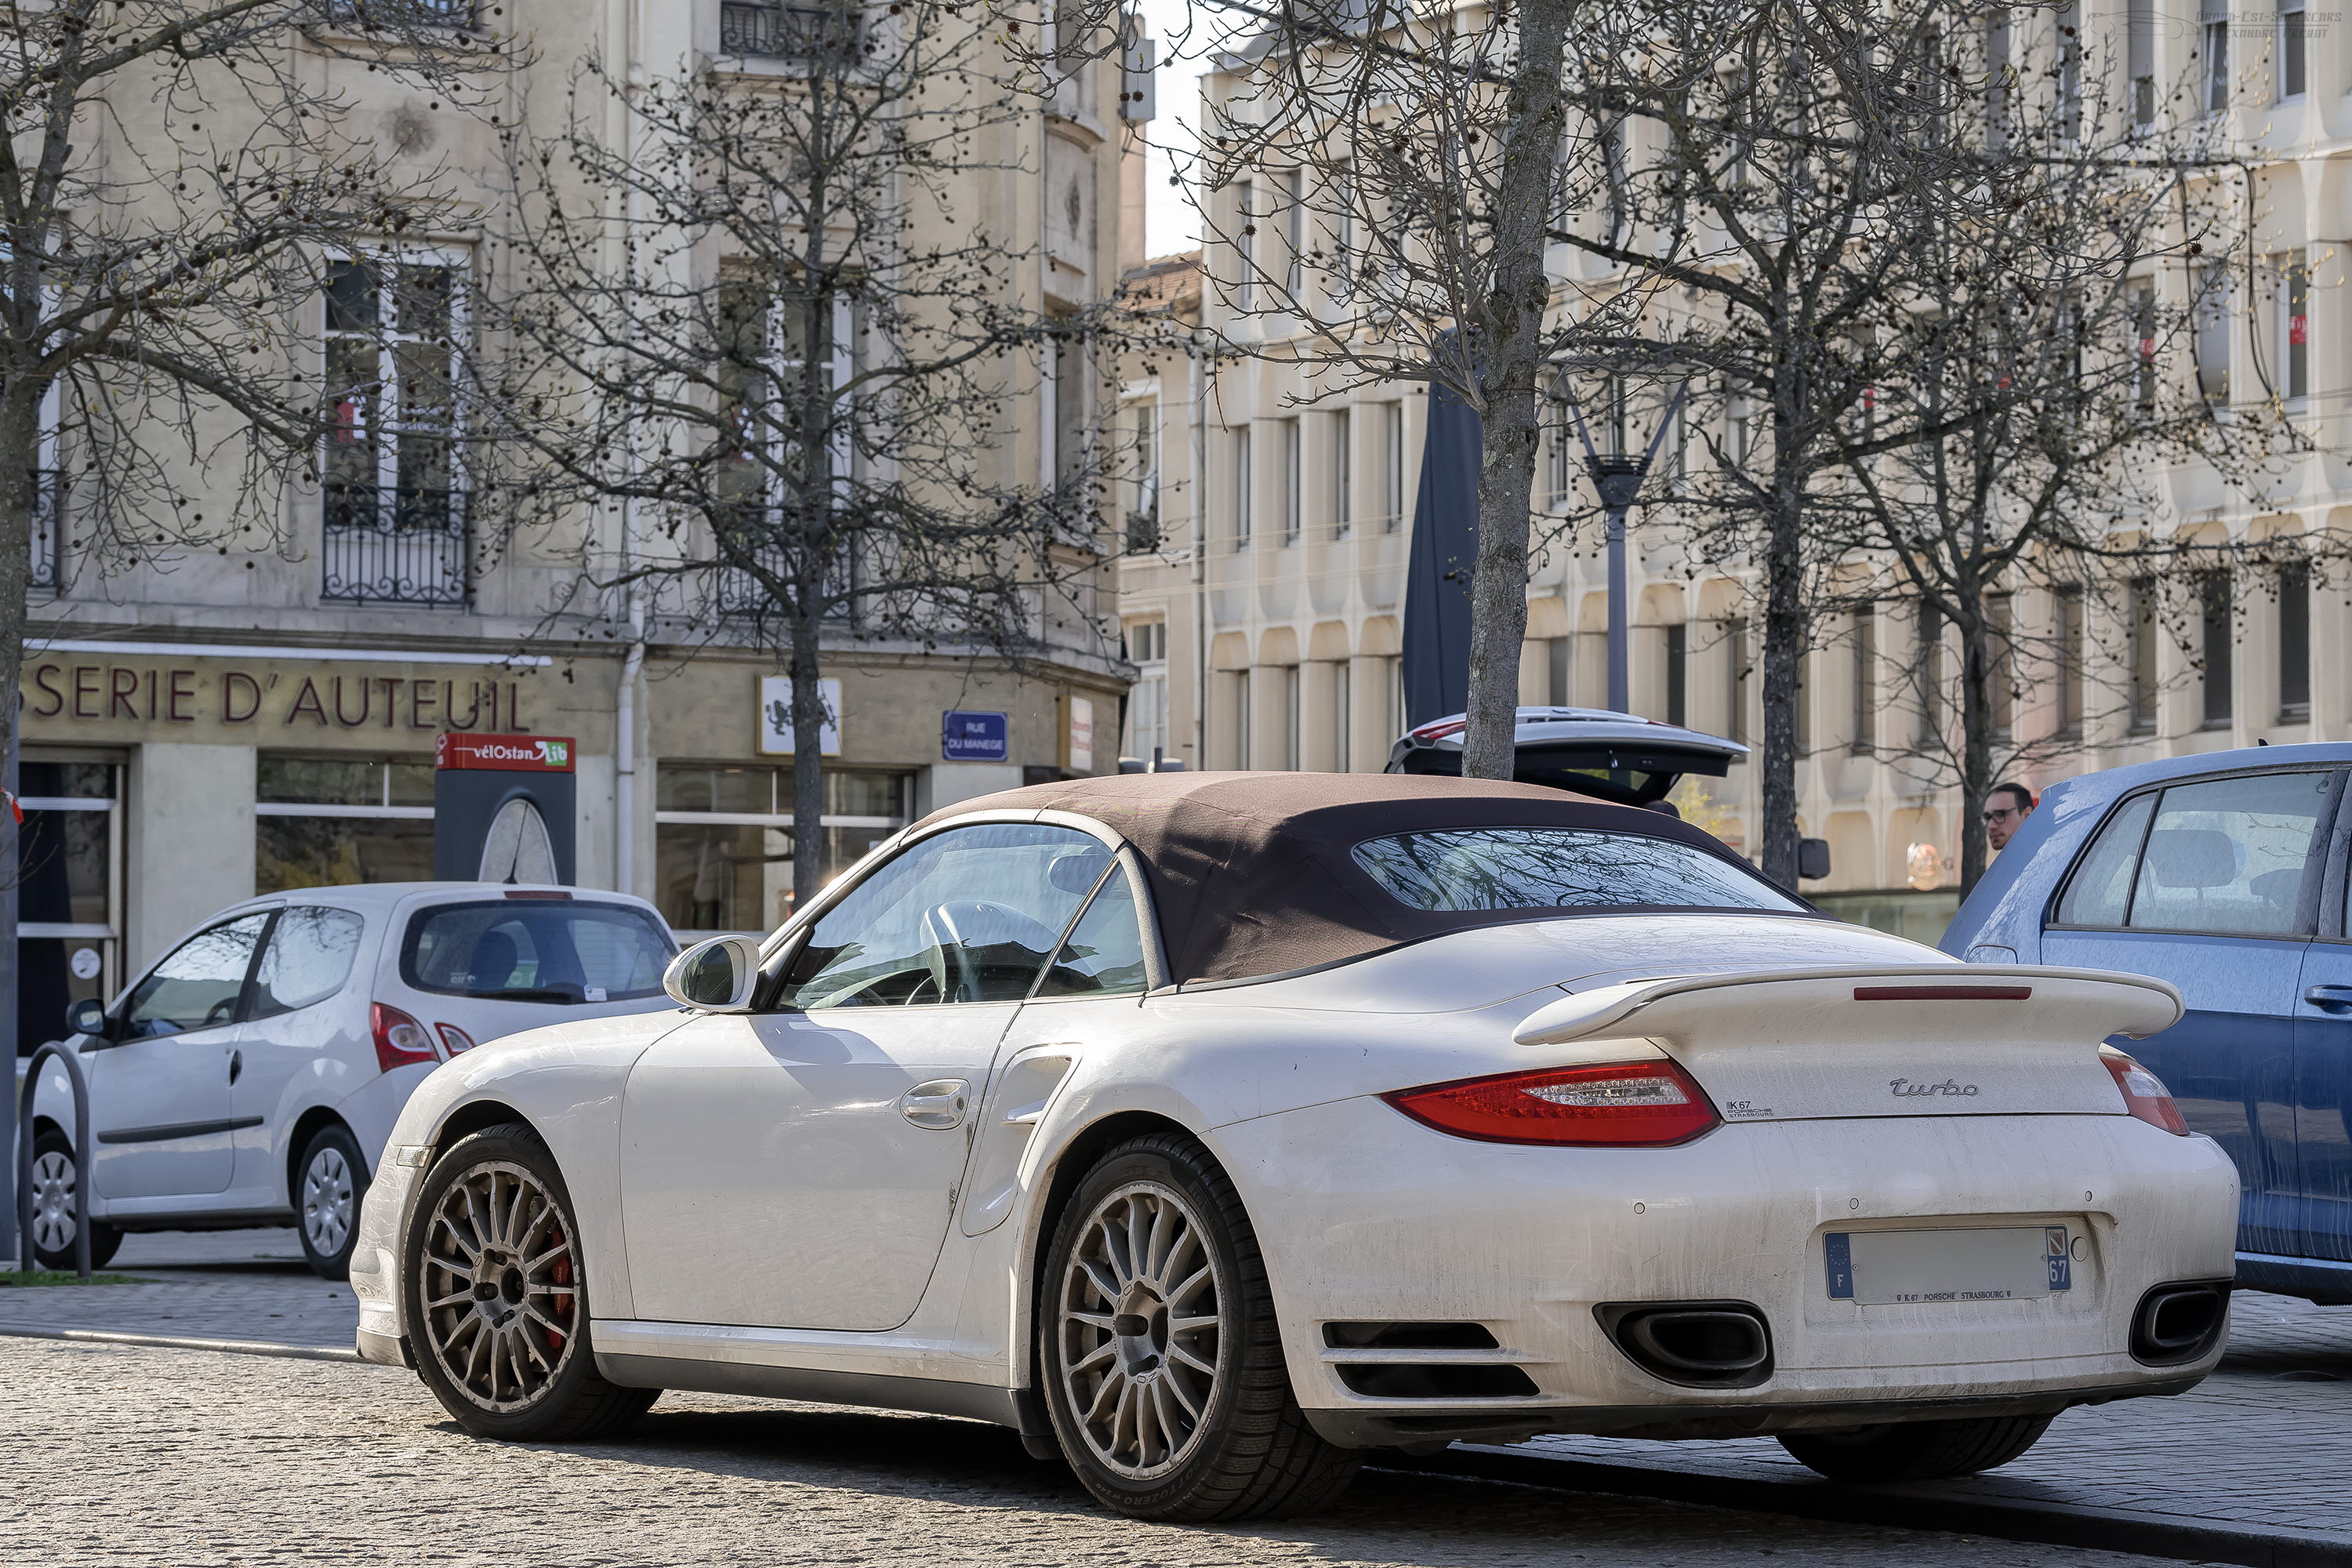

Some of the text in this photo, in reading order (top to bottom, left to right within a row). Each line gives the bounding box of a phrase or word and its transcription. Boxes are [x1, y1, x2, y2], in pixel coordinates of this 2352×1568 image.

[19, 664, 530, 732] SERIE D'AUTEUIL
[966, 722, 986, 733] RUE
[948, 739, 963, 749] DU
[1739, 1101, 1751, 1109] 67
[2049, 1260, 2067, 1282] 67
[1837, 1274, 1844, 1287] F
[1961, 1290, 2004, 1299] STRASBOURG
[1123, 1460, 1201, 1505] SOTTOZERO
